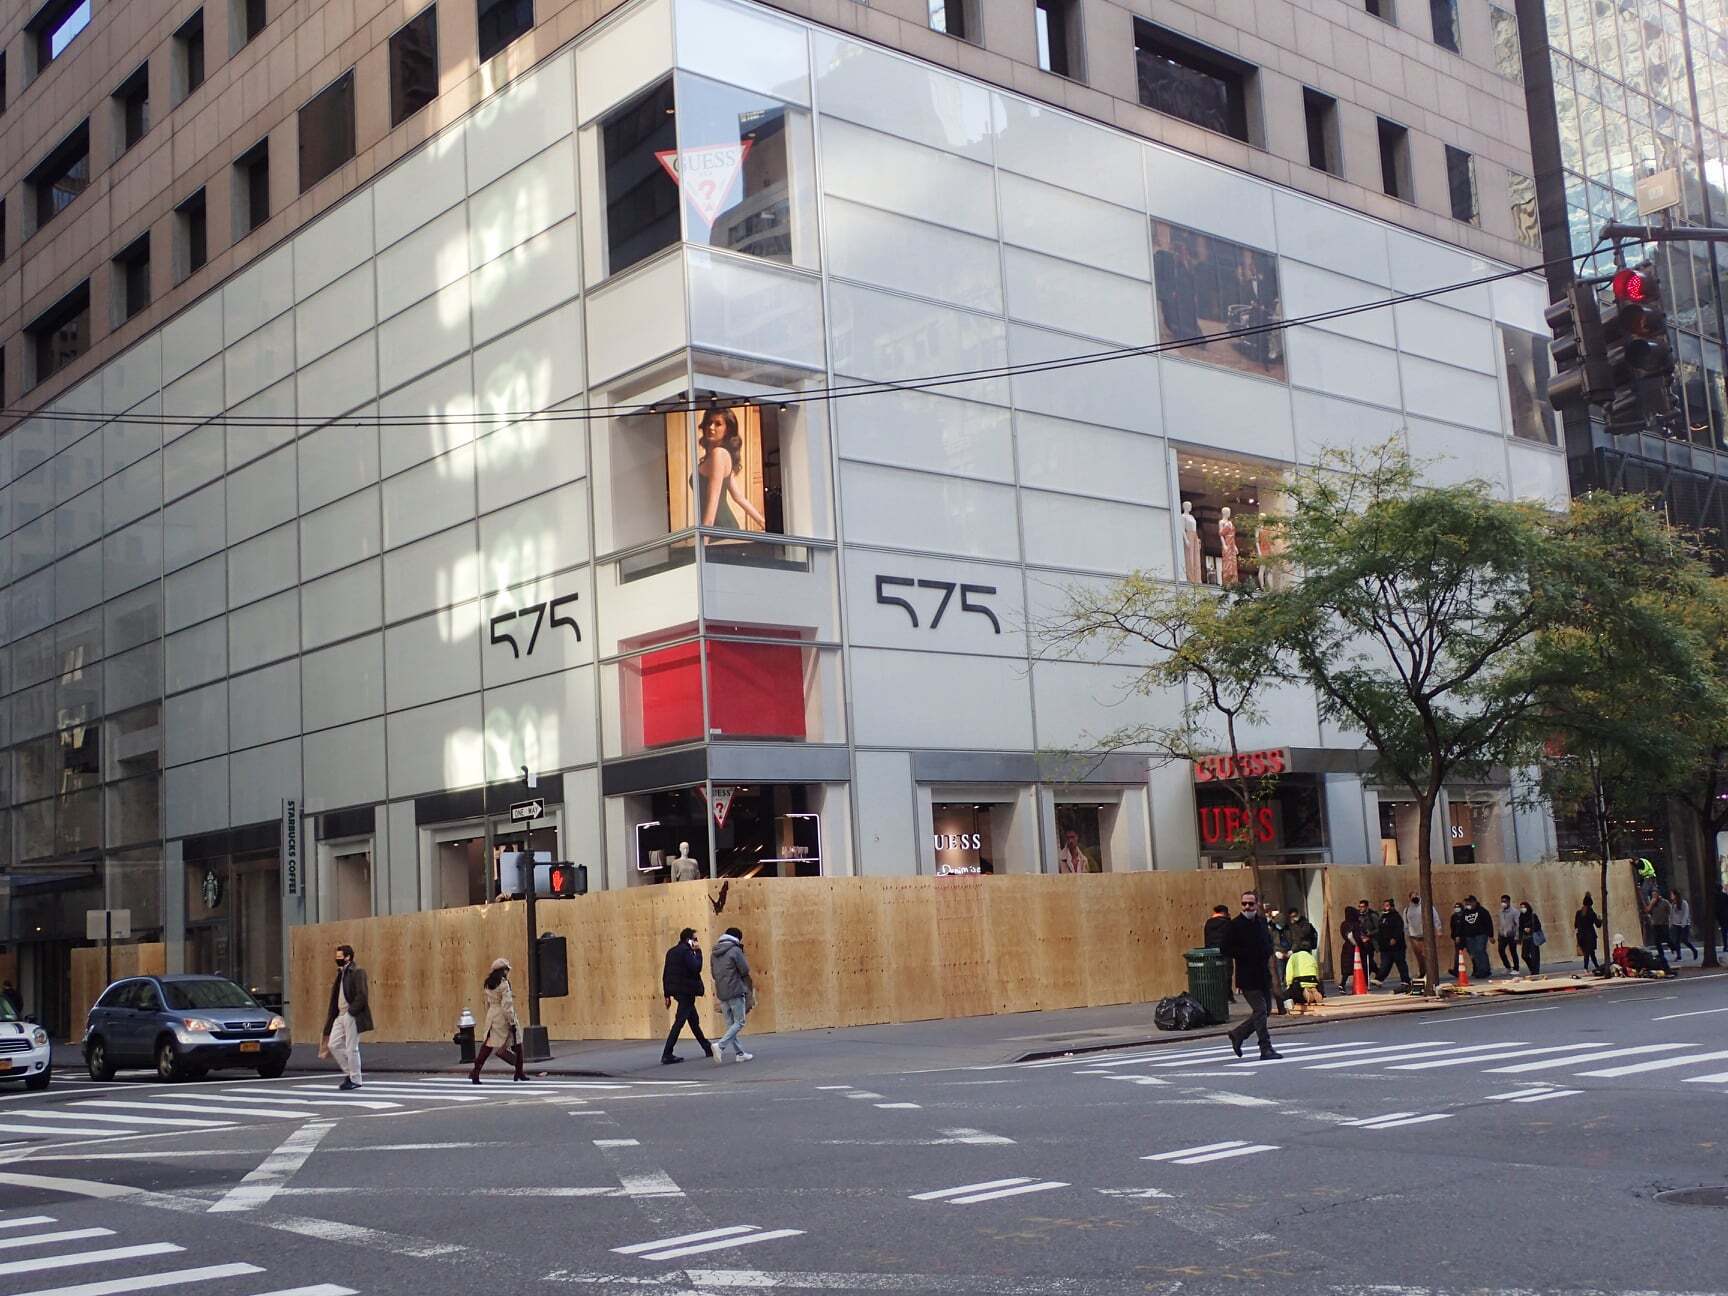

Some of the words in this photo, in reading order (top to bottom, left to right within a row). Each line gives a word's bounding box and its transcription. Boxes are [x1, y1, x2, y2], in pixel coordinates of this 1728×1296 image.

[490, 592, 582, 659] 575
[876, 574, 1001, 634] 575
[287, 800, 297, 857] STARBUCKS
[514, 809, 524, 817] ONE
[528, 804, 539, 814] WAY
[288, 859, 298, 895] COFFEE
